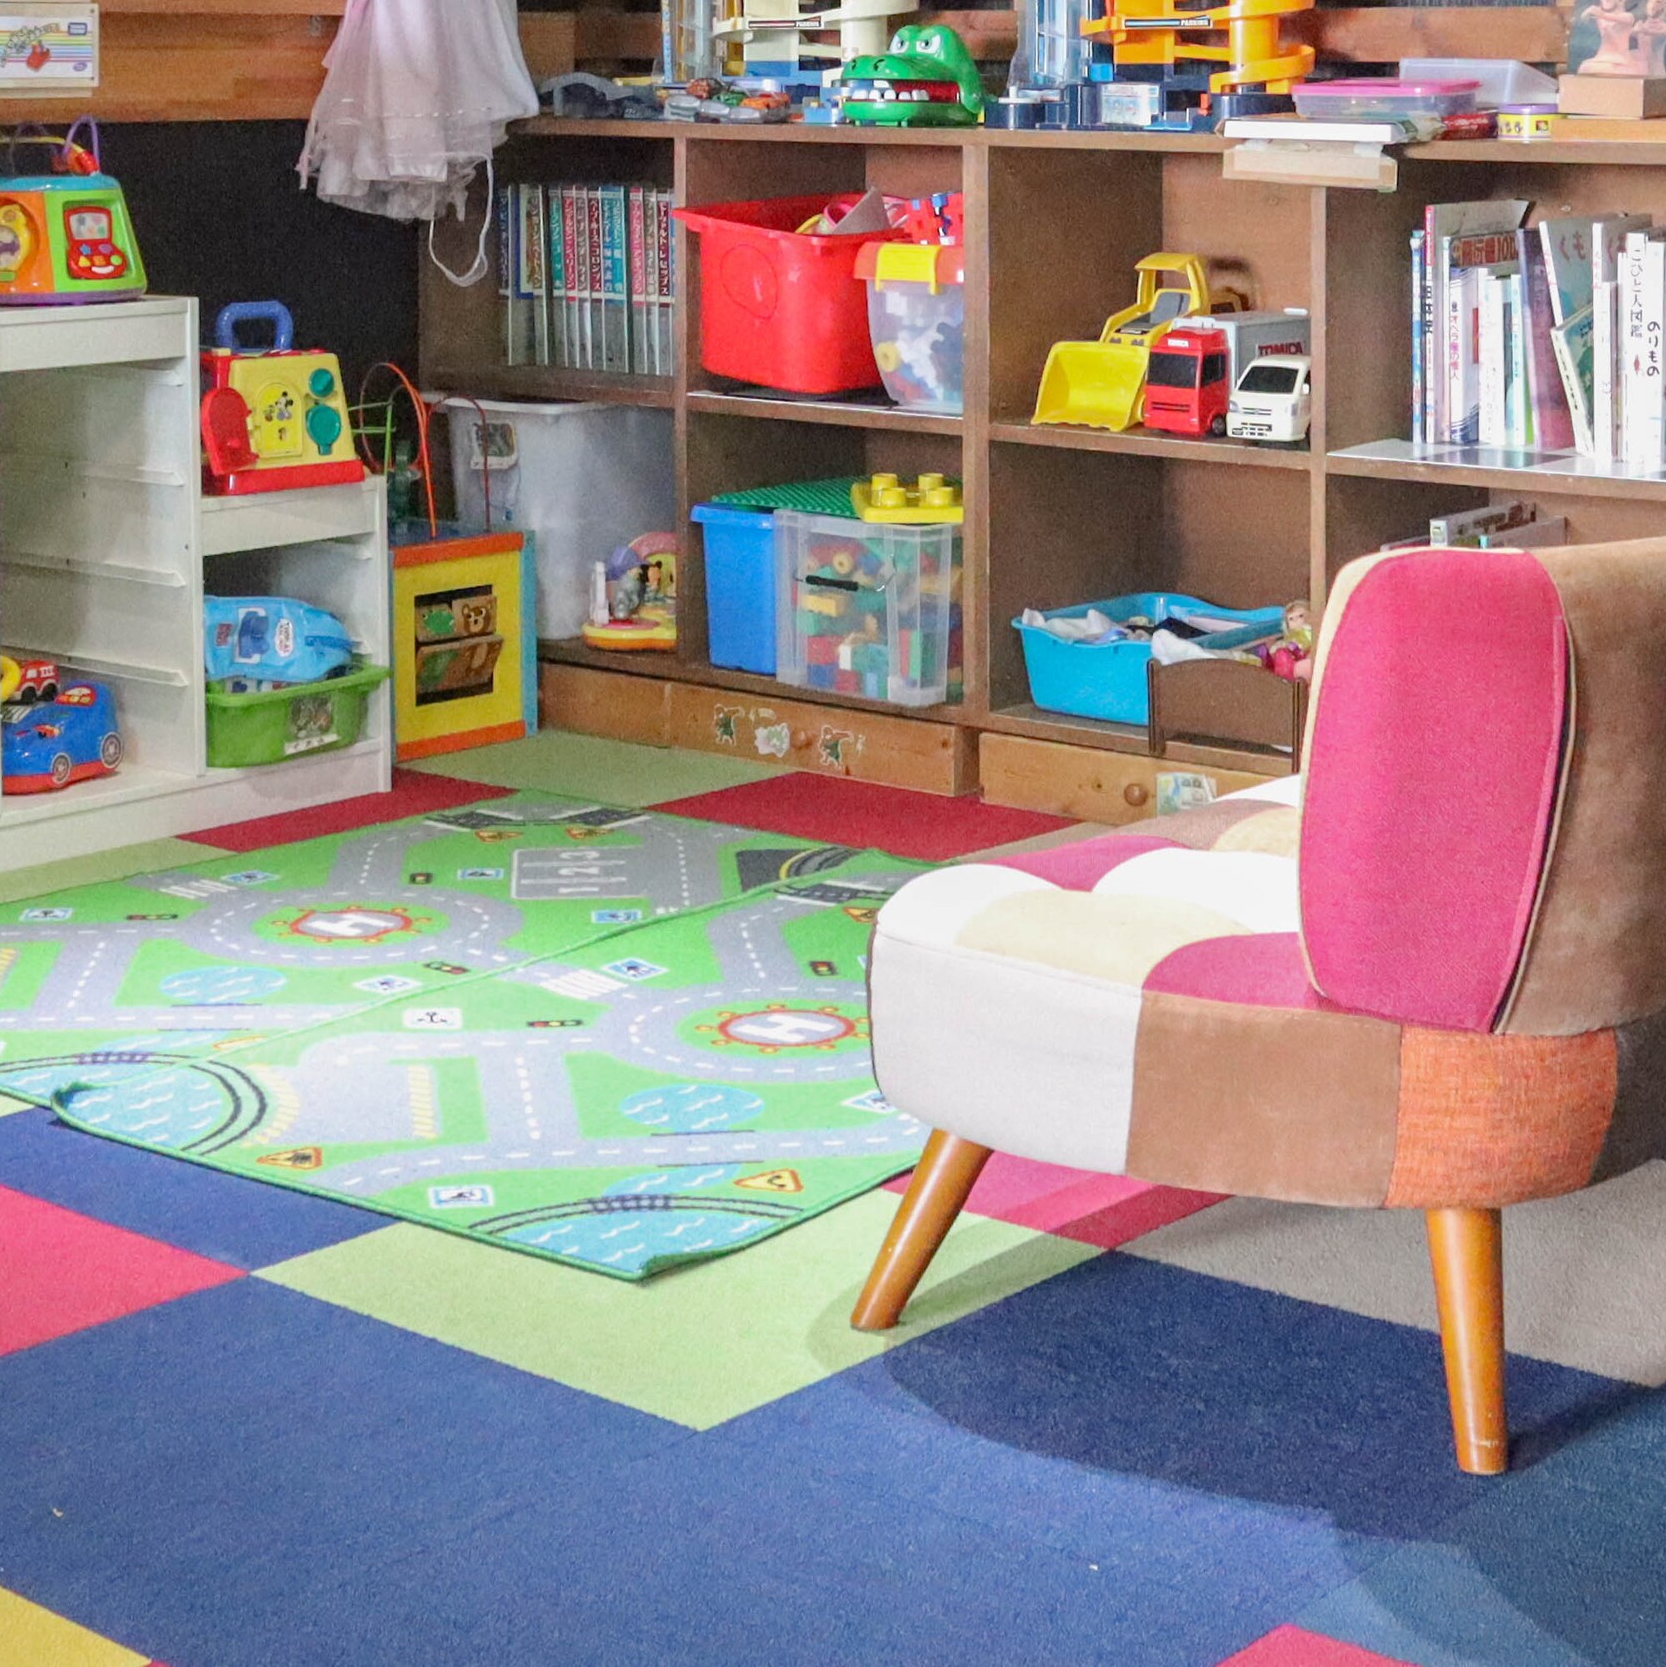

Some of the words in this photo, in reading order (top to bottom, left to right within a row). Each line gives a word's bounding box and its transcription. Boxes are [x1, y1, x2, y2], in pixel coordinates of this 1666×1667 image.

[1180, 19, 1209, 27] PARKING
[1646, 319, 1662, 378] のりもの
[559, 850, 601, 860] 3
[557, 866, 601, 876] 2
[557, 886, 600, 894] 1
[307, 913, 395, 937] H
[735, 1013, 836, 1043] H
